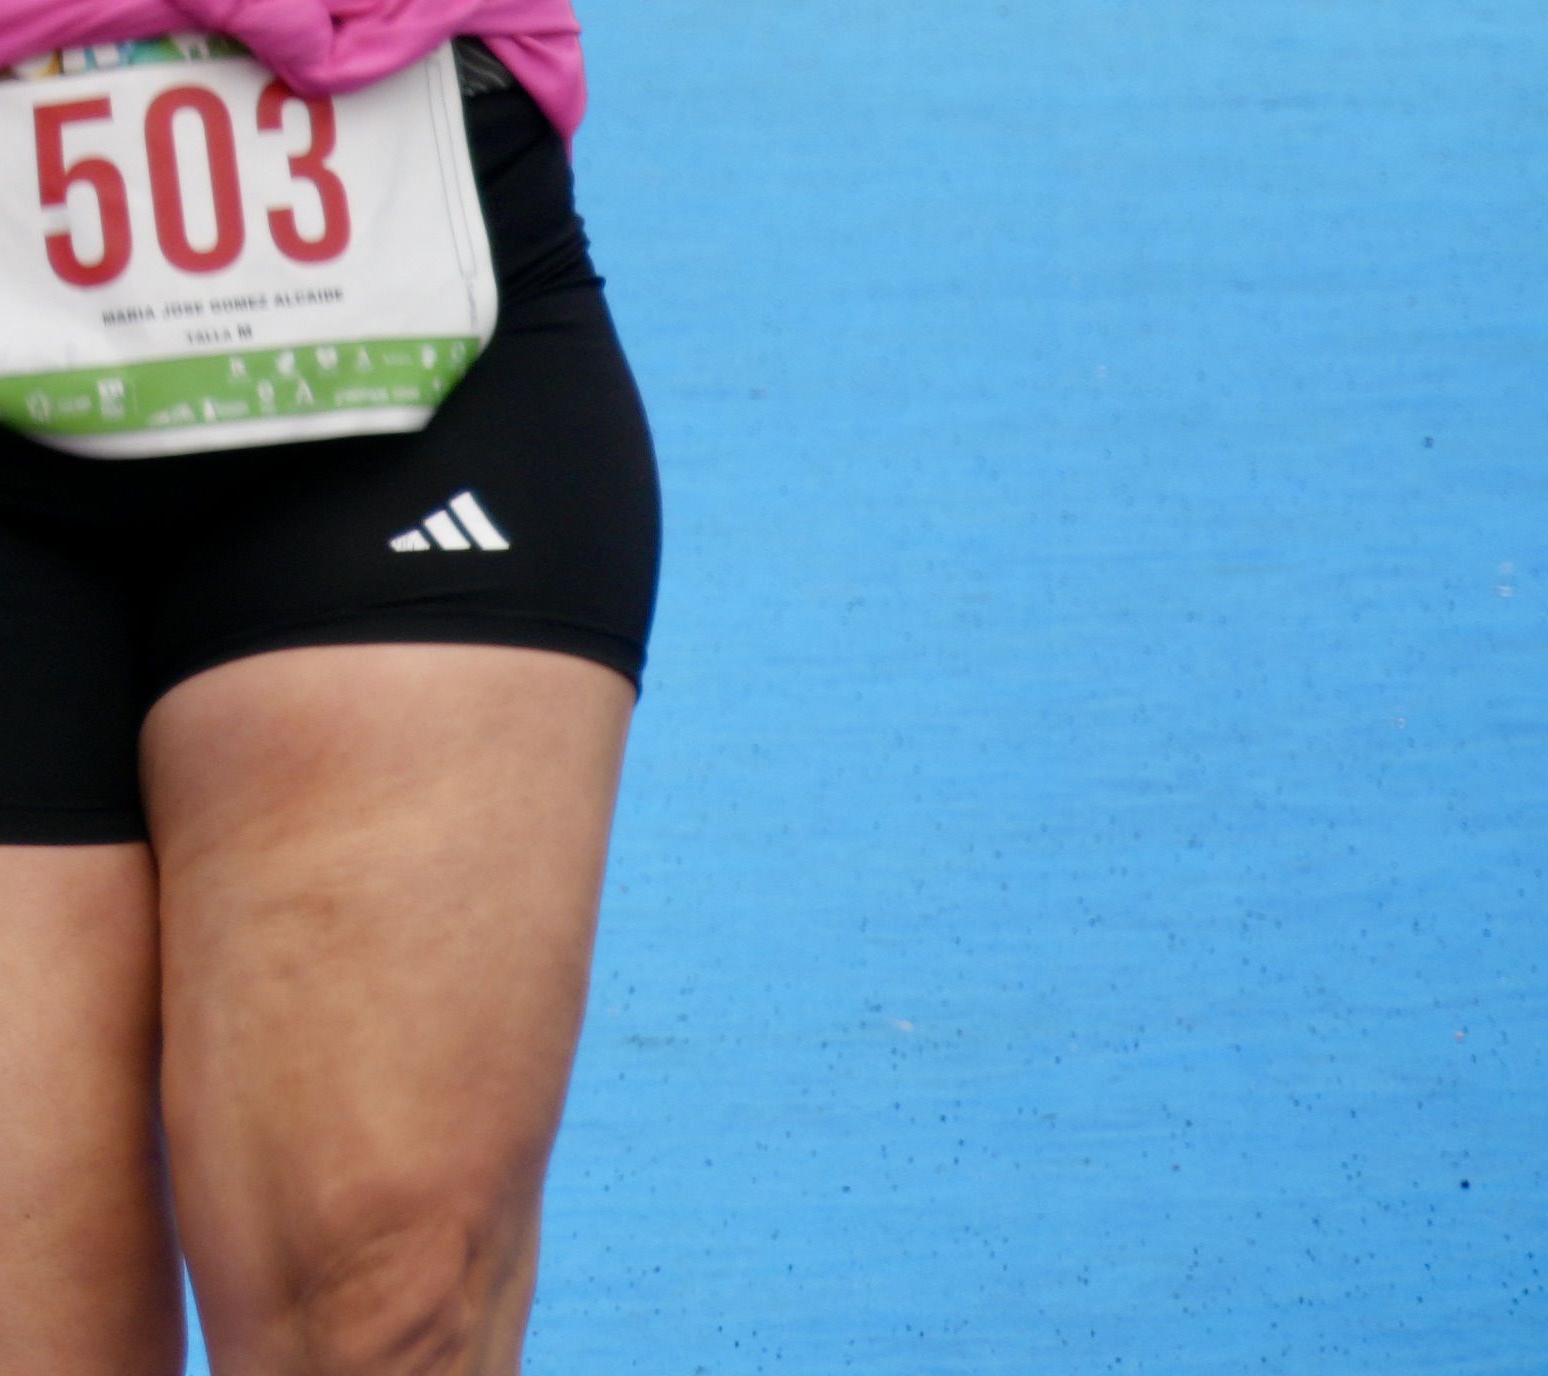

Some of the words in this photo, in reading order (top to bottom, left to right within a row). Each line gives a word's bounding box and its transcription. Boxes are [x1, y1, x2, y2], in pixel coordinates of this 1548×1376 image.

[31, 78, 351, 291] 503
[101, 306, 156, 329] MARIA
[162, 300, 206, 321] JOSE
[237, 322, 253, 341] M
